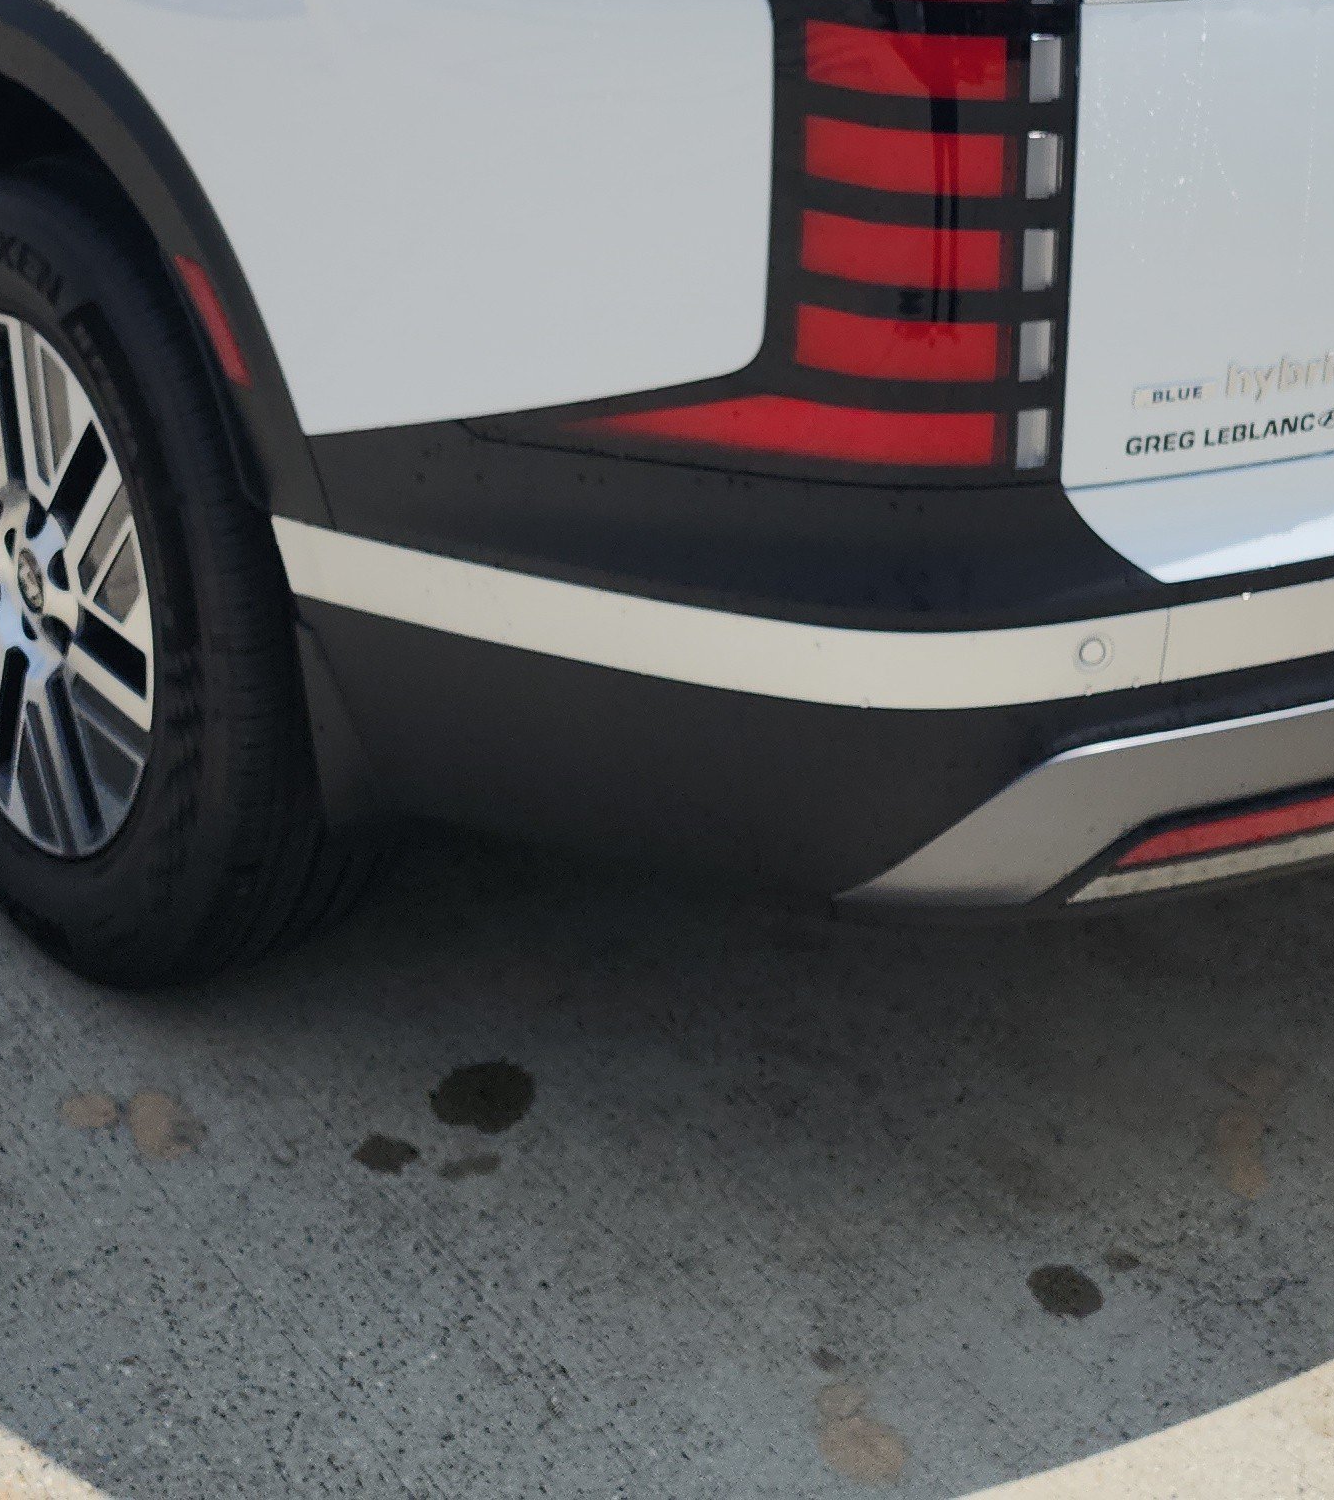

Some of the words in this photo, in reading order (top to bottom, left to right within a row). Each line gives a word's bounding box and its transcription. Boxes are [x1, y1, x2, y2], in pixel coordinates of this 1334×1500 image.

[1151, 385, 1204, 404] BLUE
[1124, 429, 1196, 457] GREG
[1203, 411, 1316, 448] LEBLANC
